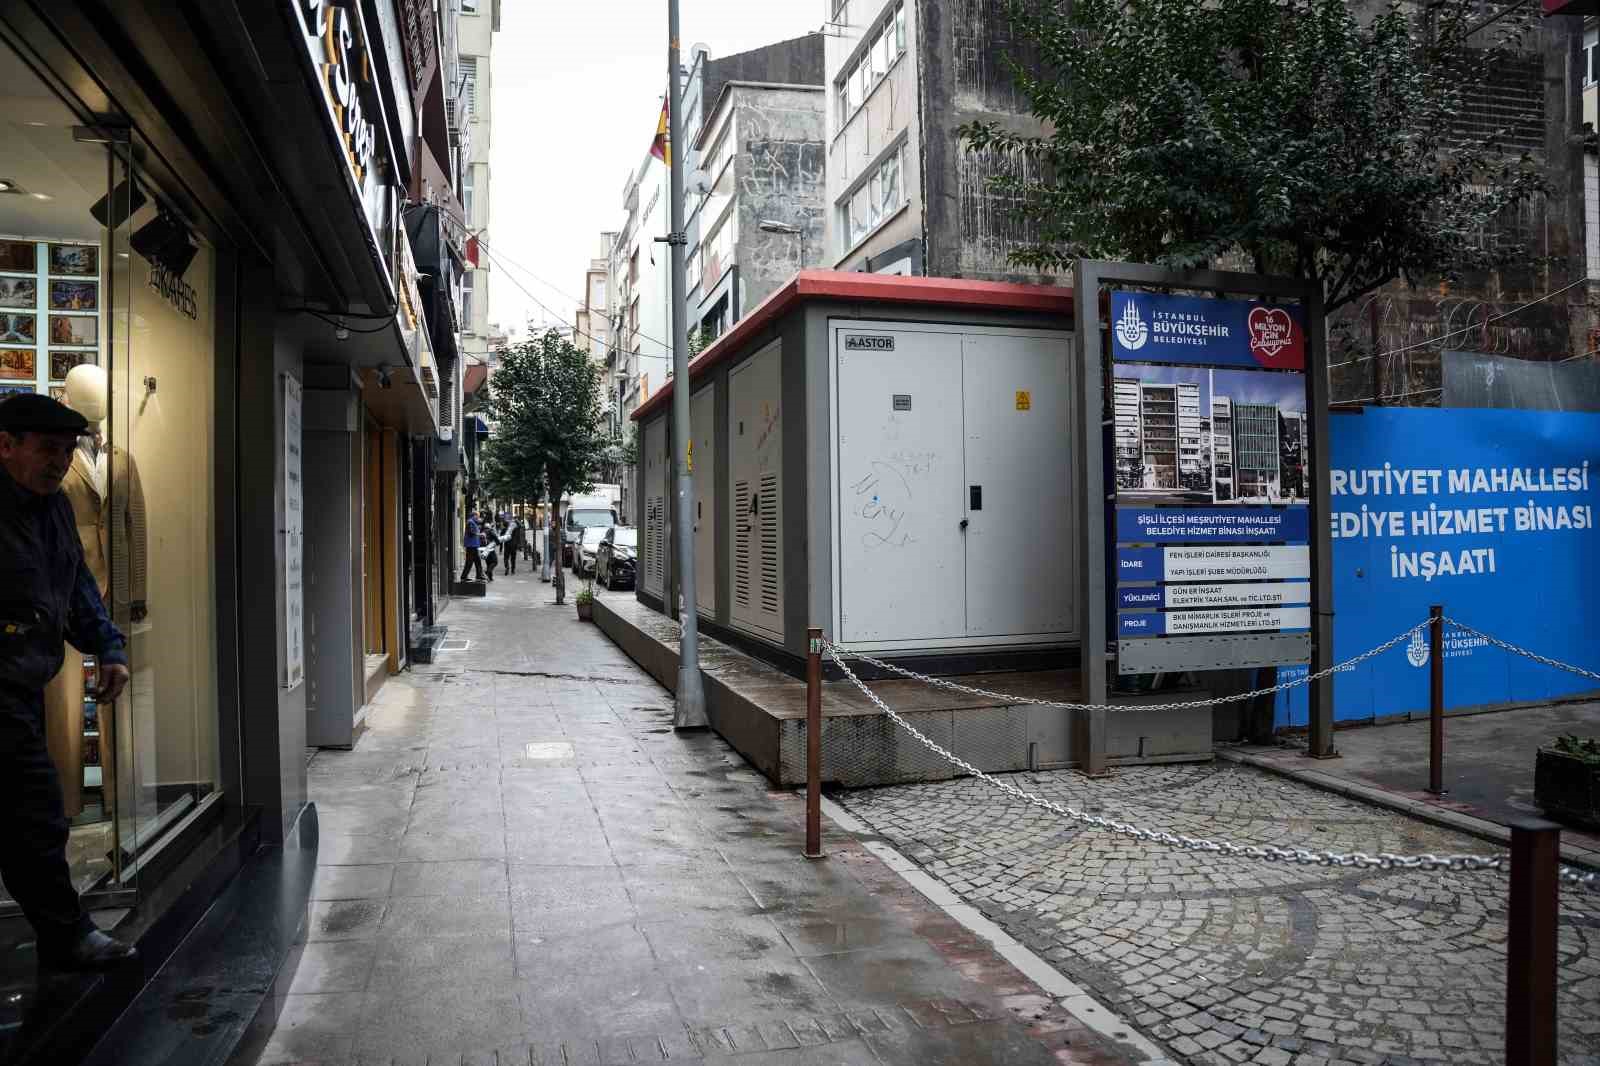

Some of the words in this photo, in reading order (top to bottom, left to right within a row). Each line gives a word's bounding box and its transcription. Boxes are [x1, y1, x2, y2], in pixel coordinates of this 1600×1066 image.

[1152, 310, 1206, 322] İSTANBUL
[1153, 321, 1230, 337] BÜYÜKŞEHİR
[1153, 334, 1207, 346] BELEDİYESİ
[1448, 460, 1589, 494] MAHALLESİ
[1137, 514, 1159, 525] ŞİŞLİ
[1160, 514, 1185, 524] İLÇESİ
[1187, 514, 1236, 524] MEŞRUTİYET
[1237, 515, 1281, 524] MAHALLESİ
[1412, 503, 1508, 535] HİZMET
[1515, 499, 1592, 531] BİNASI
[1146, 526, 1186, 535] BELEDİYE
[1188, 526, 1217, 535] HİZMET
[1219, 526, 1245, 535] BİNASI
[1246, 527, 1276, 536] İNŞAATI
[1121, 560, 1143, 568] İDARE
[1391, 545, 1496, 581] İNŞAATI
[1124, 620, 1147, 628] PROJE
